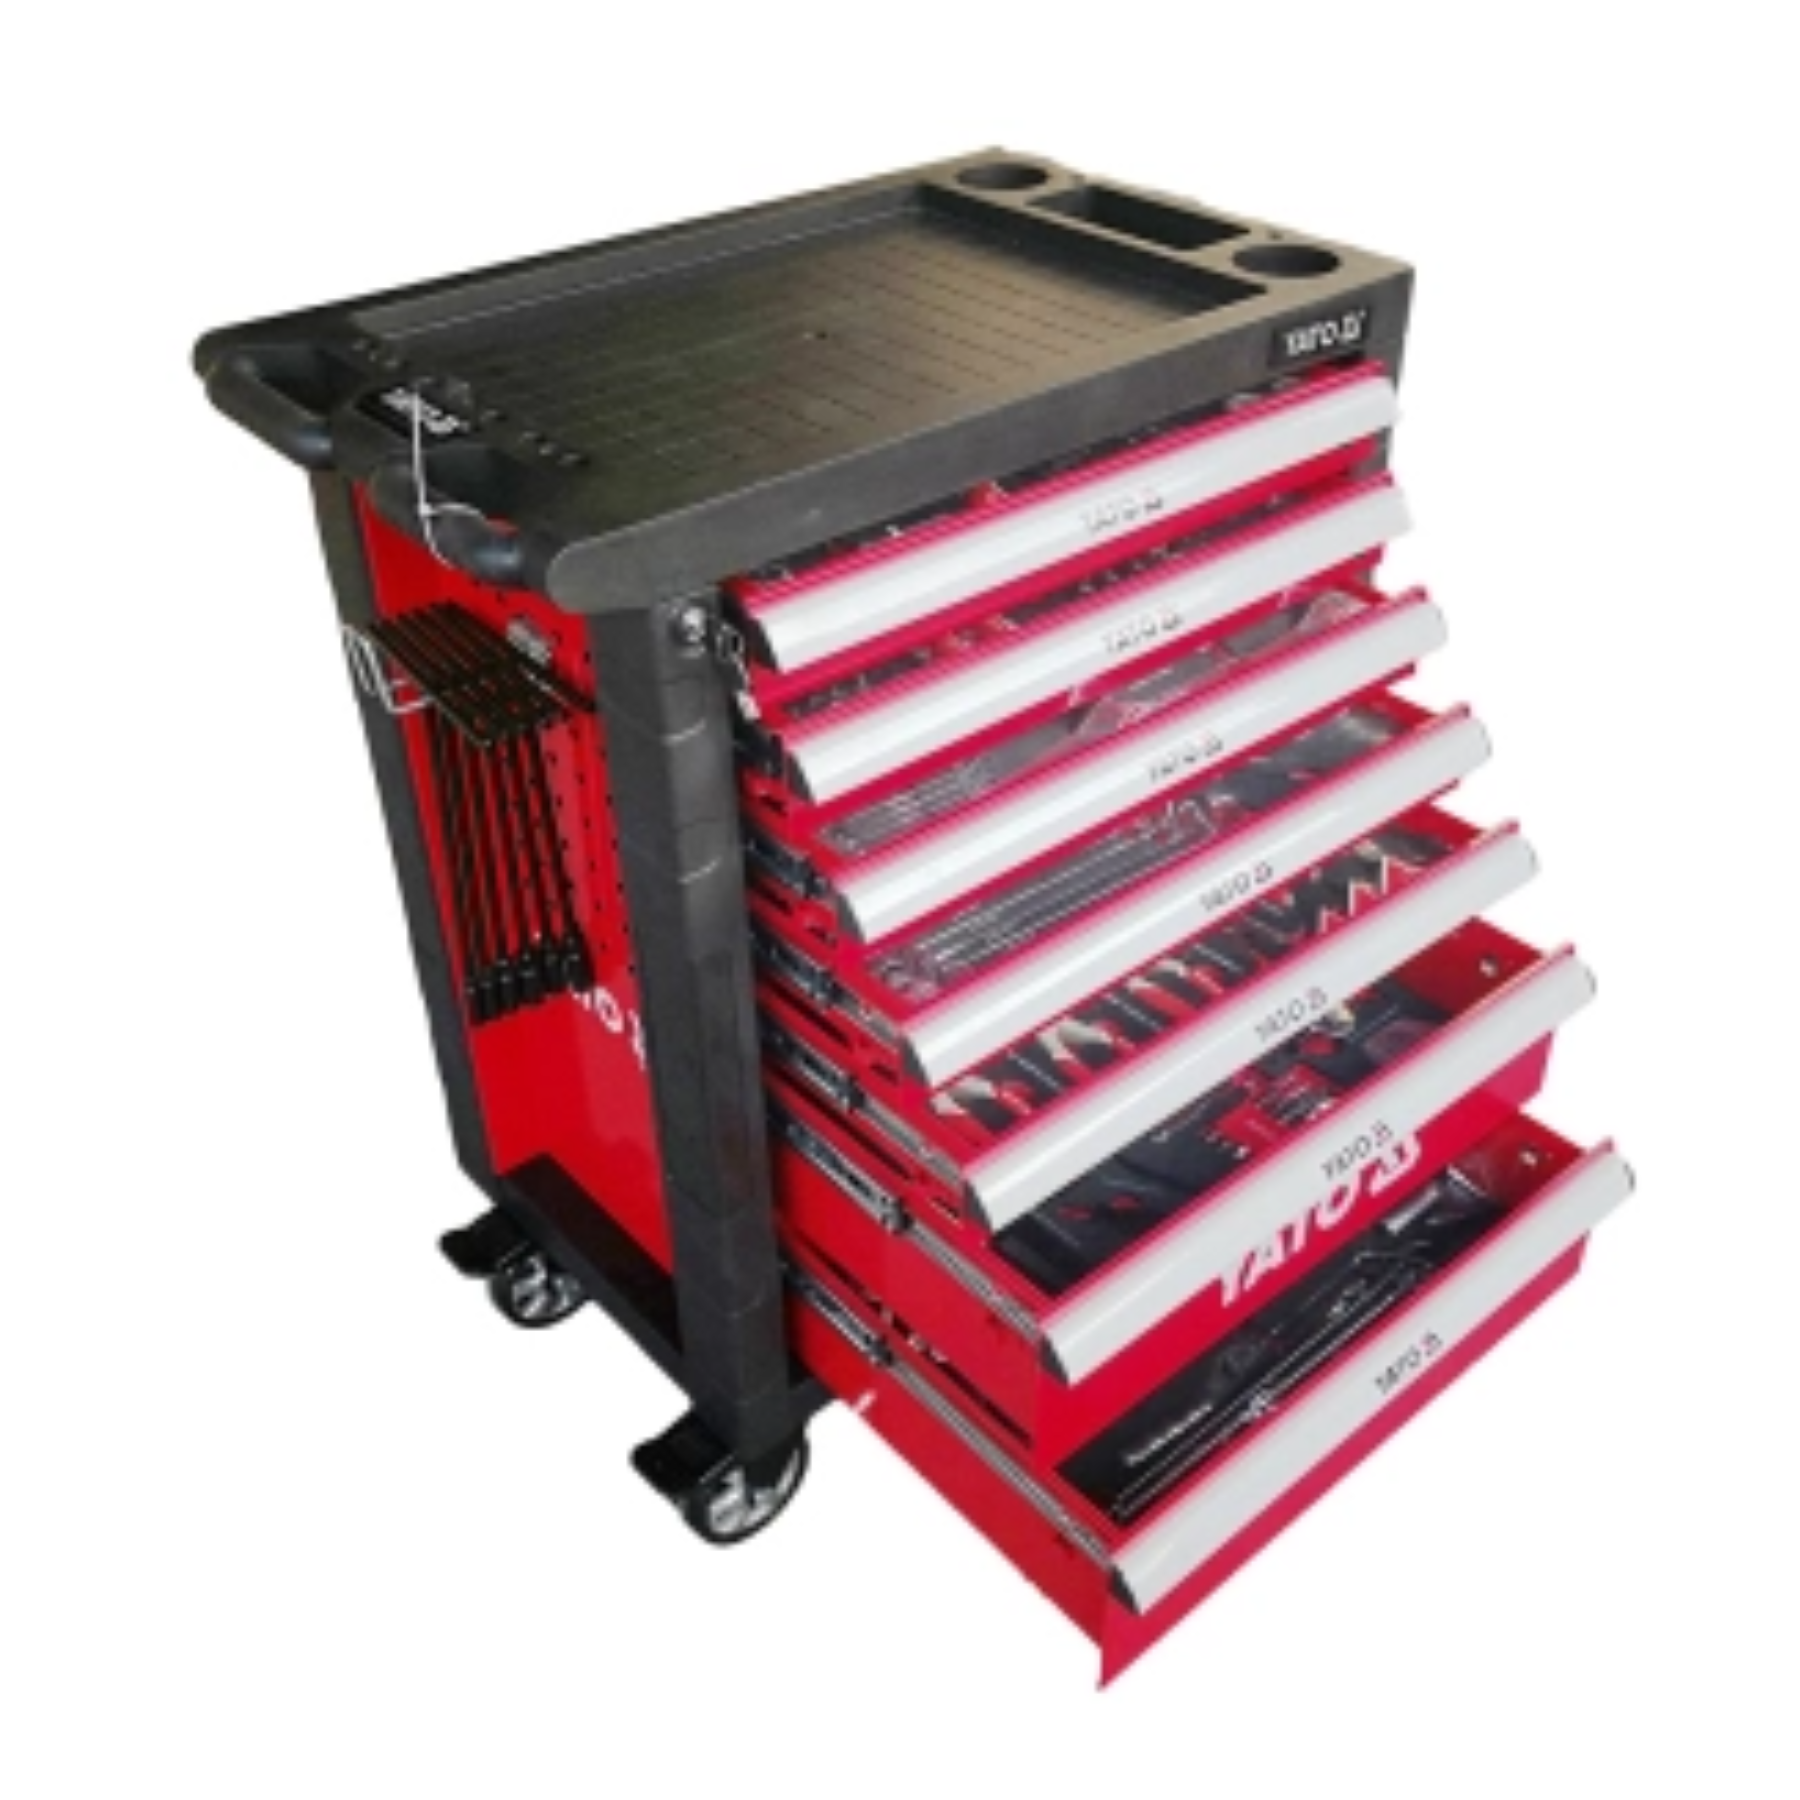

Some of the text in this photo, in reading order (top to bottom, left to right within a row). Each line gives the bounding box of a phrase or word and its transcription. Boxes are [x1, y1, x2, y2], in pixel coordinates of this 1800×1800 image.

[1285, 319, 1341, 355] YATO
[1322, 1135, 1372, 1177] YATO
[1220, 1173, 1362, 1307] YATO
[1374, 1344, 1422, 1395] YATO
